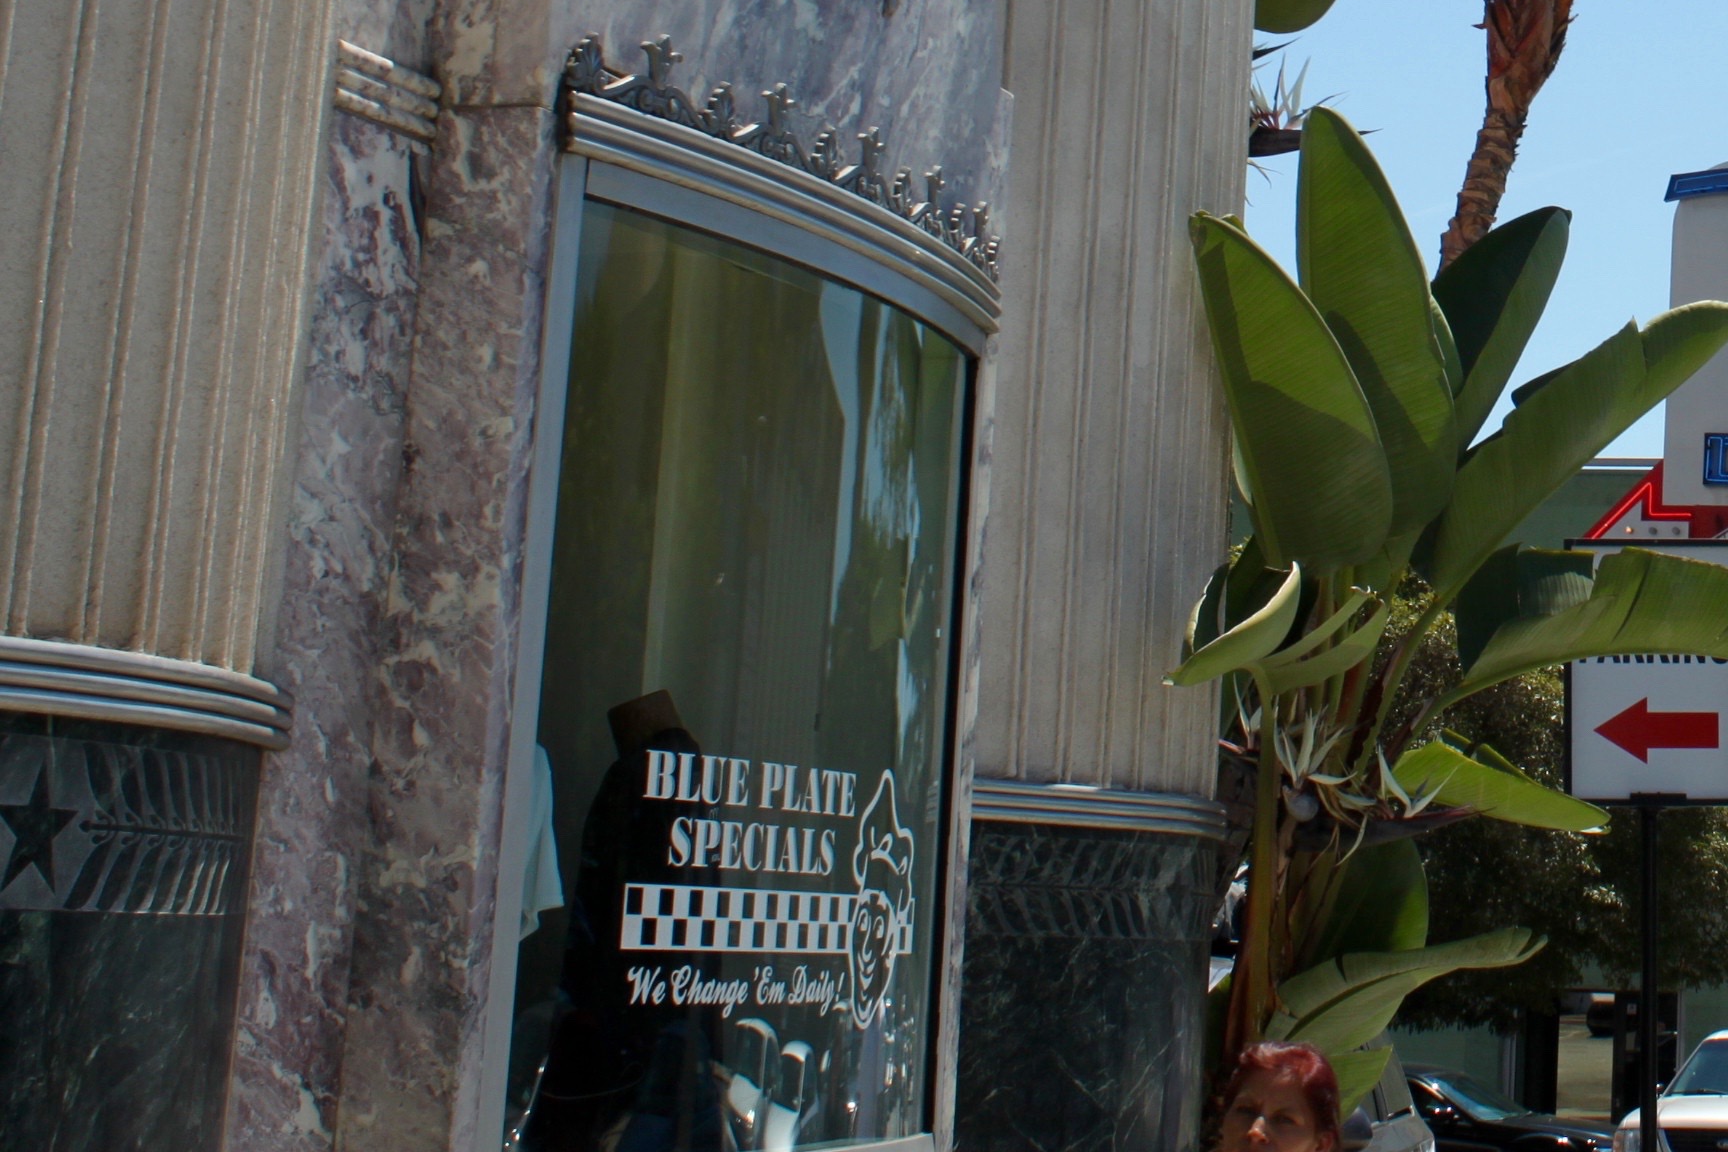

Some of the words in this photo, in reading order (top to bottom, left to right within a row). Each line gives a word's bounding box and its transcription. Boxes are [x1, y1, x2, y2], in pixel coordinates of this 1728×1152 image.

[642, 748, 751, 807] BLUE
[759, 761, 857, 817] PLATE
[666, 816, 837, 876] SPECIALS
[626, 964, 666, 1005] We
[670, 964, 749, 1019] Change
[752, 967, 786, 1004] 'Em
[787, 964, 845, 1017] Daily!
